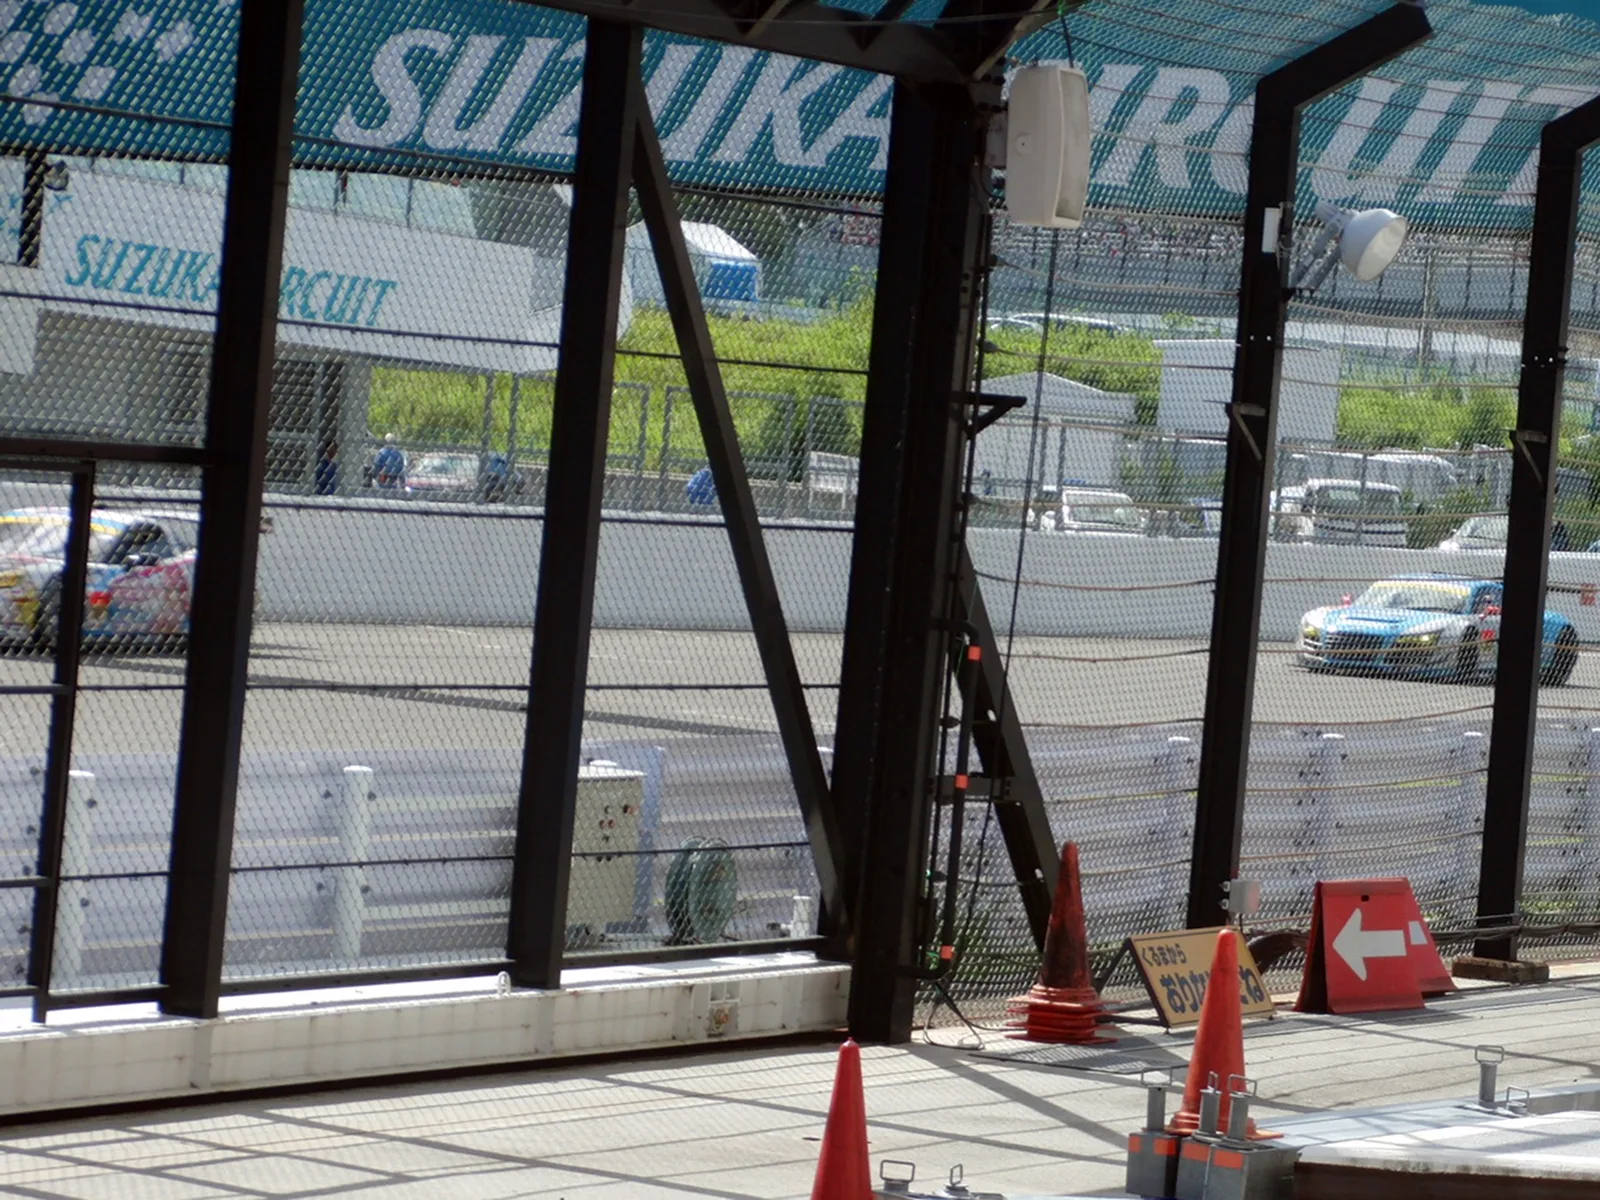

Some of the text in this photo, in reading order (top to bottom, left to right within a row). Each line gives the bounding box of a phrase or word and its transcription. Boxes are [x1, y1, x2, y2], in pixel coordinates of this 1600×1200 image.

[1141, 944, 1187, 967] くるまから
